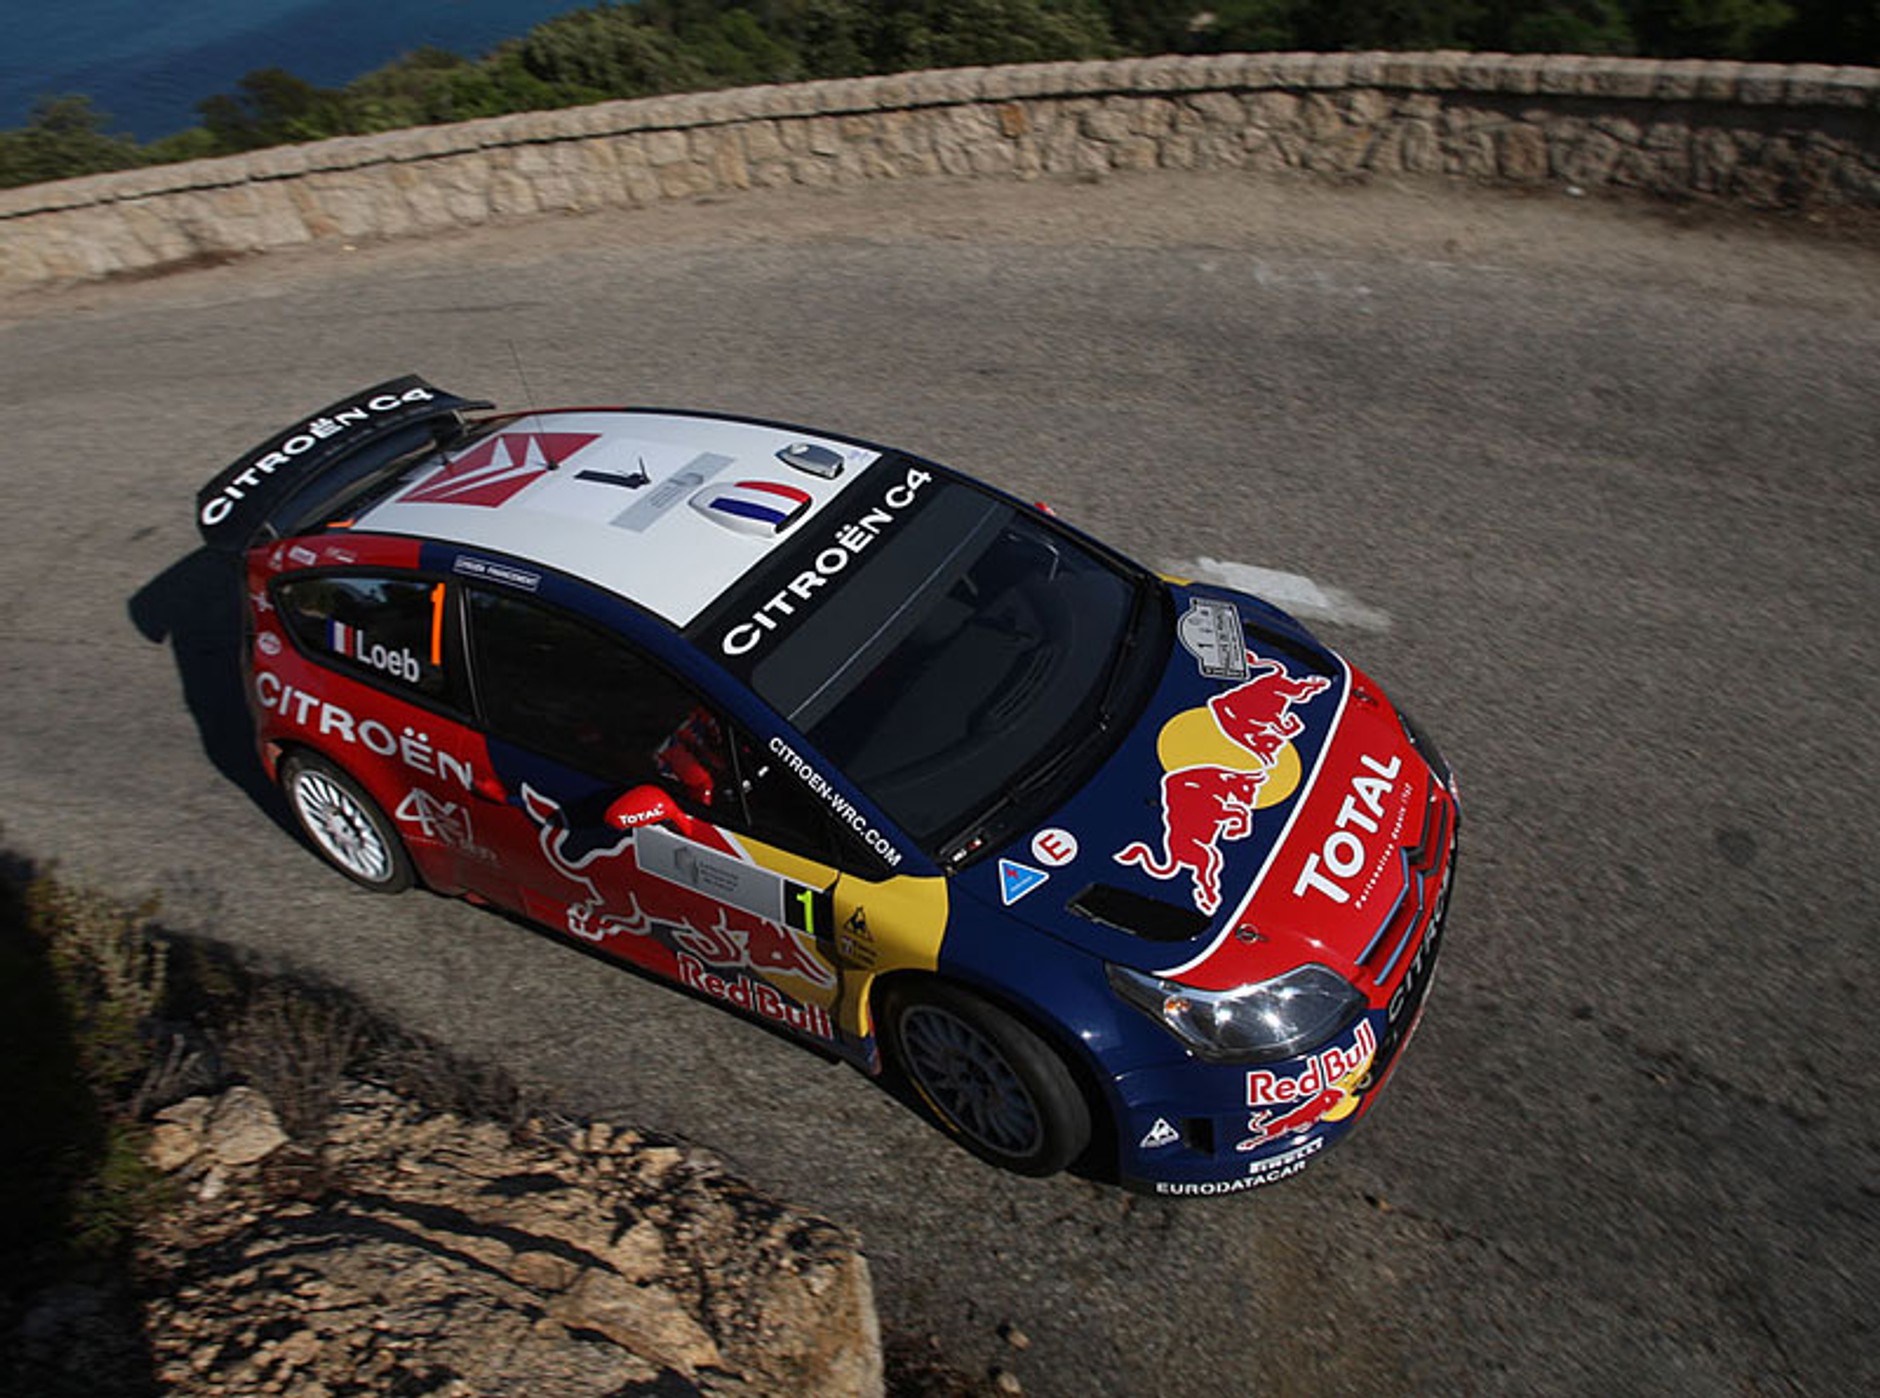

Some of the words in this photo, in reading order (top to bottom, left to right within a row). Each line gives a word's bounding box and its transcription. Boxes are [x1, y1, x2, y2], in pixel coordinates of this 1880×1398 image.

[201, 406, 369, 526] CITROËN
[368, 387, 434, 411] C4
[721, 507, 894, 655] CITROËN
[885, 467, 933, 509] C4
[356, 629, 420, 683] Loeb
[430, 582, 446, 667] 1
[256, 671, 474, 790] CITROËN
[618, 803, 666, 825] TOTAL
[768, 737, 903, 867] CITROEN-WRC.COM
[1292, 753, 1402, 905] TOTAL
[1037, 833, 1072, 862] E
[796, 889, 814, 935] 1
[676, 951, 752, 1012] Red
[753, 980, 834, 1041] Bull
[1246, 1056, 1321, 1106] Red
[1321, 1017, 1378, 1084] Bull
[1155, 1159, 1307, 1195] EURODATACAR
